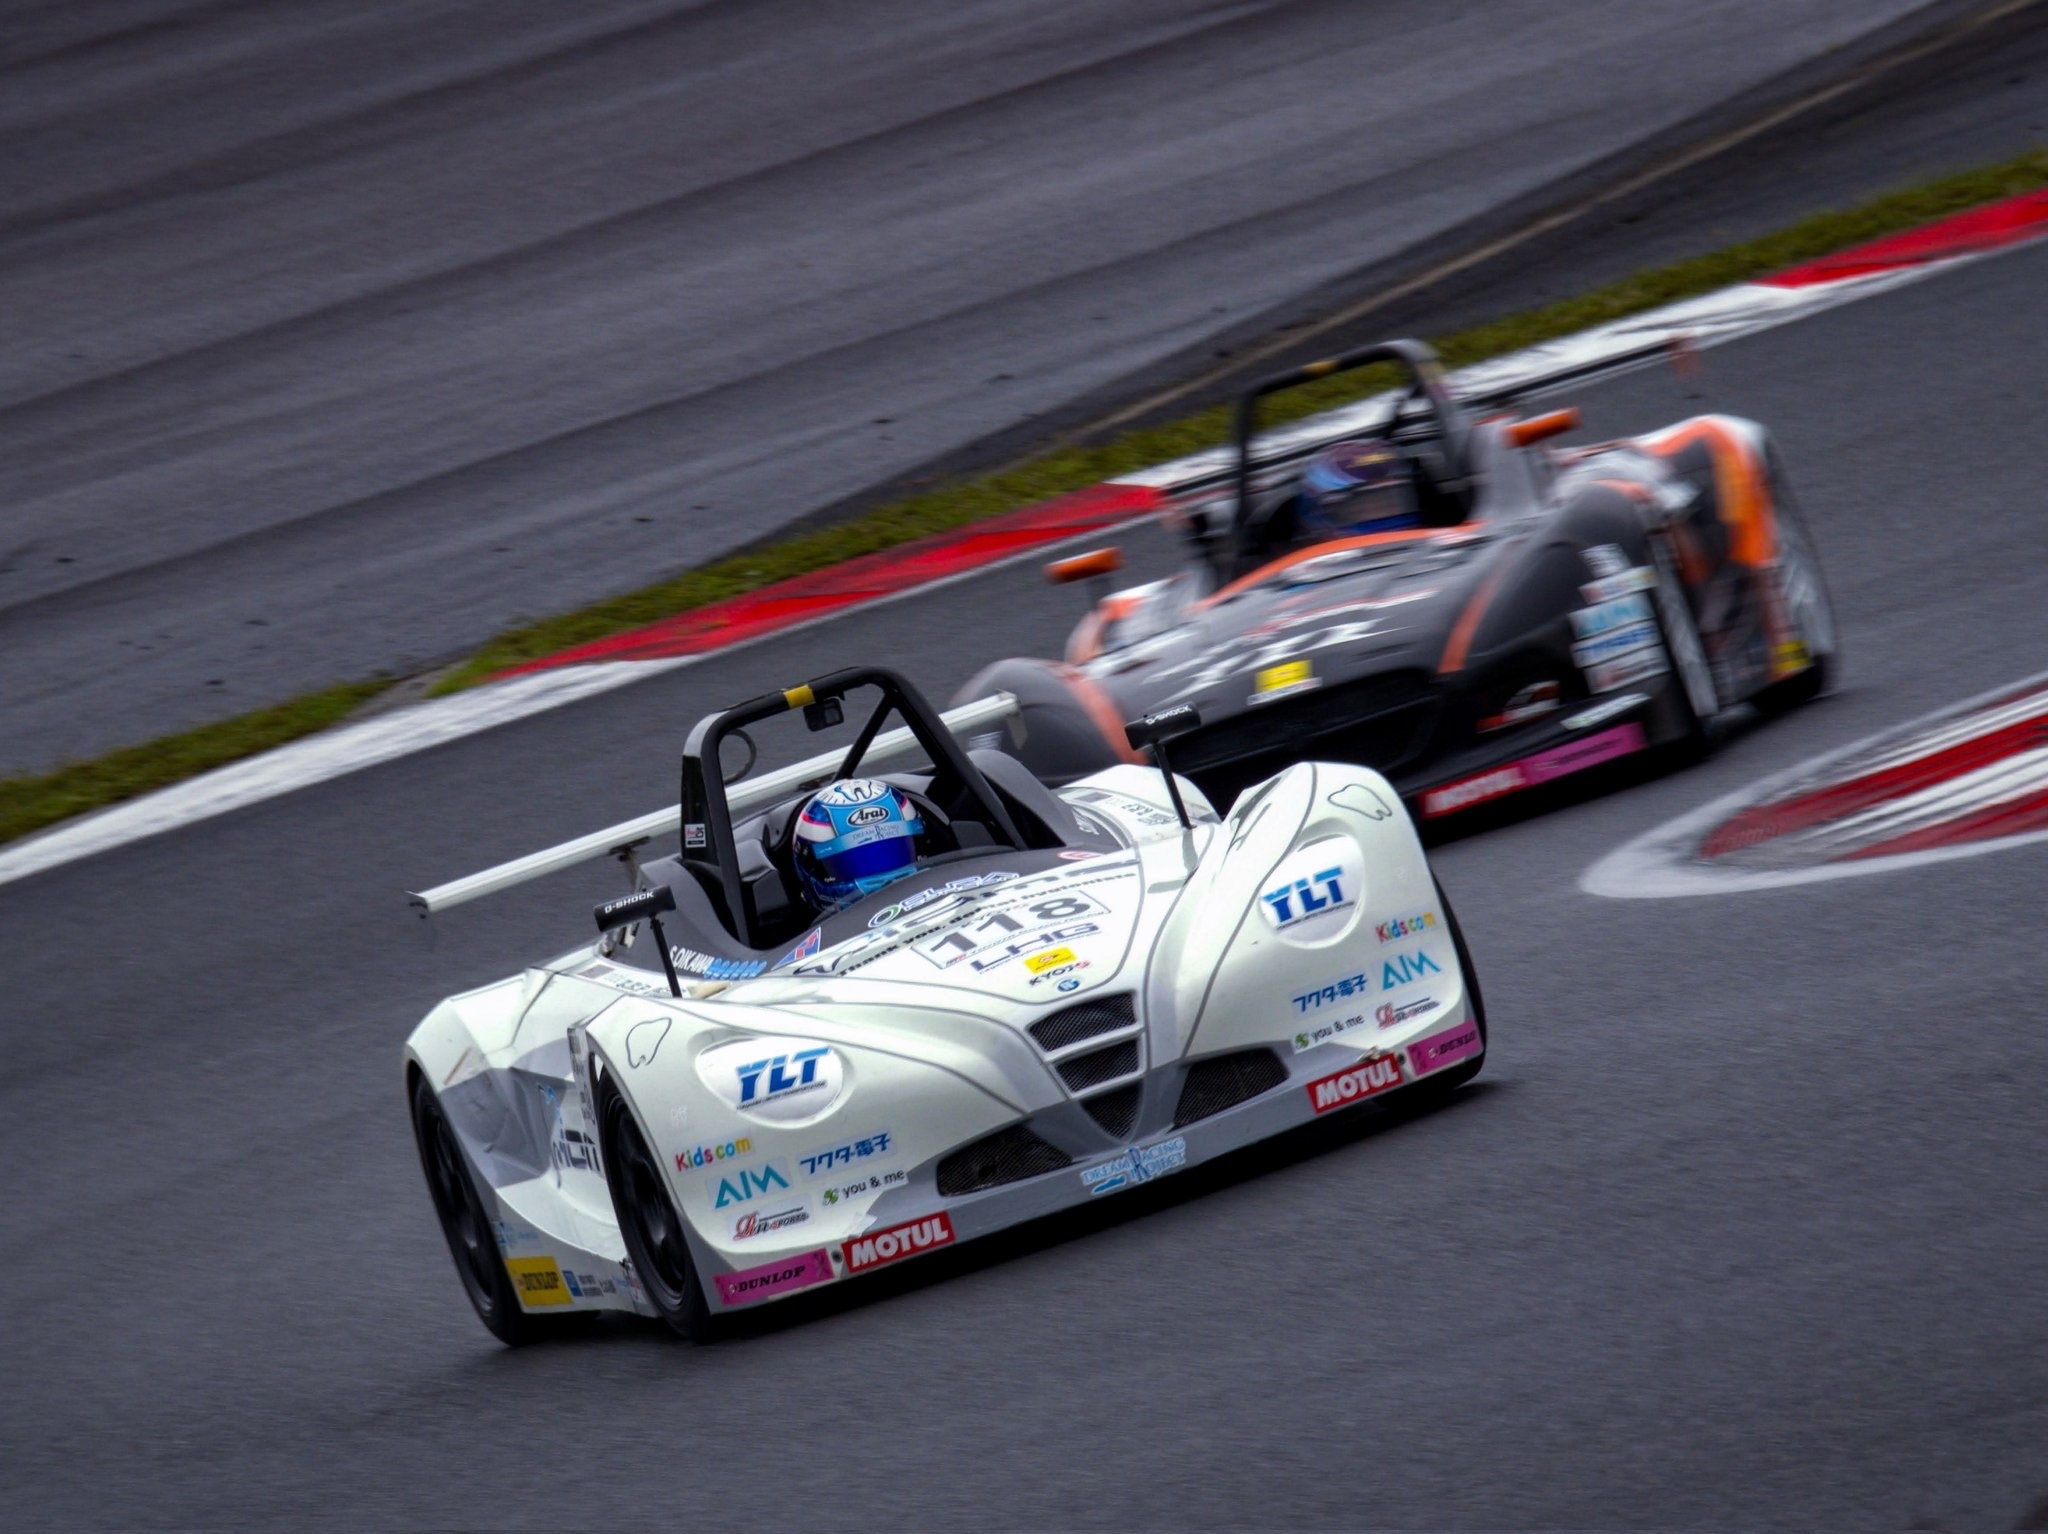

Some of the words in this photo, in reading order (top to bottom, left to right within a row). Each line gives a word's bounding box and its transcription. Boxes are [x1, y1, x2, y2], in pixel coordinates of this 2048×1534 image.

[852, 807, 884, 821] Arai
[604, 891, 654, 914] G-SHOCK
[930, 898, 1091, 952] 118
[1382, 951, 1441, 990] AIM
[1311, 1026, 1333, 1043] you
[1333, 1020, 1345, 1032] &
[1346, 1015, 1365, 1028] me
[1315, 1058, 1399, 1109] MOTUL
[713, 1164, 790, 1209] AIM
[842, 1181, 867, 1199] you
[869, 1176, 881, 1188] &
[884, 1170, 904, 1183] me
[851, 1217, 949, 1268] MOTUL
[738, 1265, 807, 1292] DUNLOP
